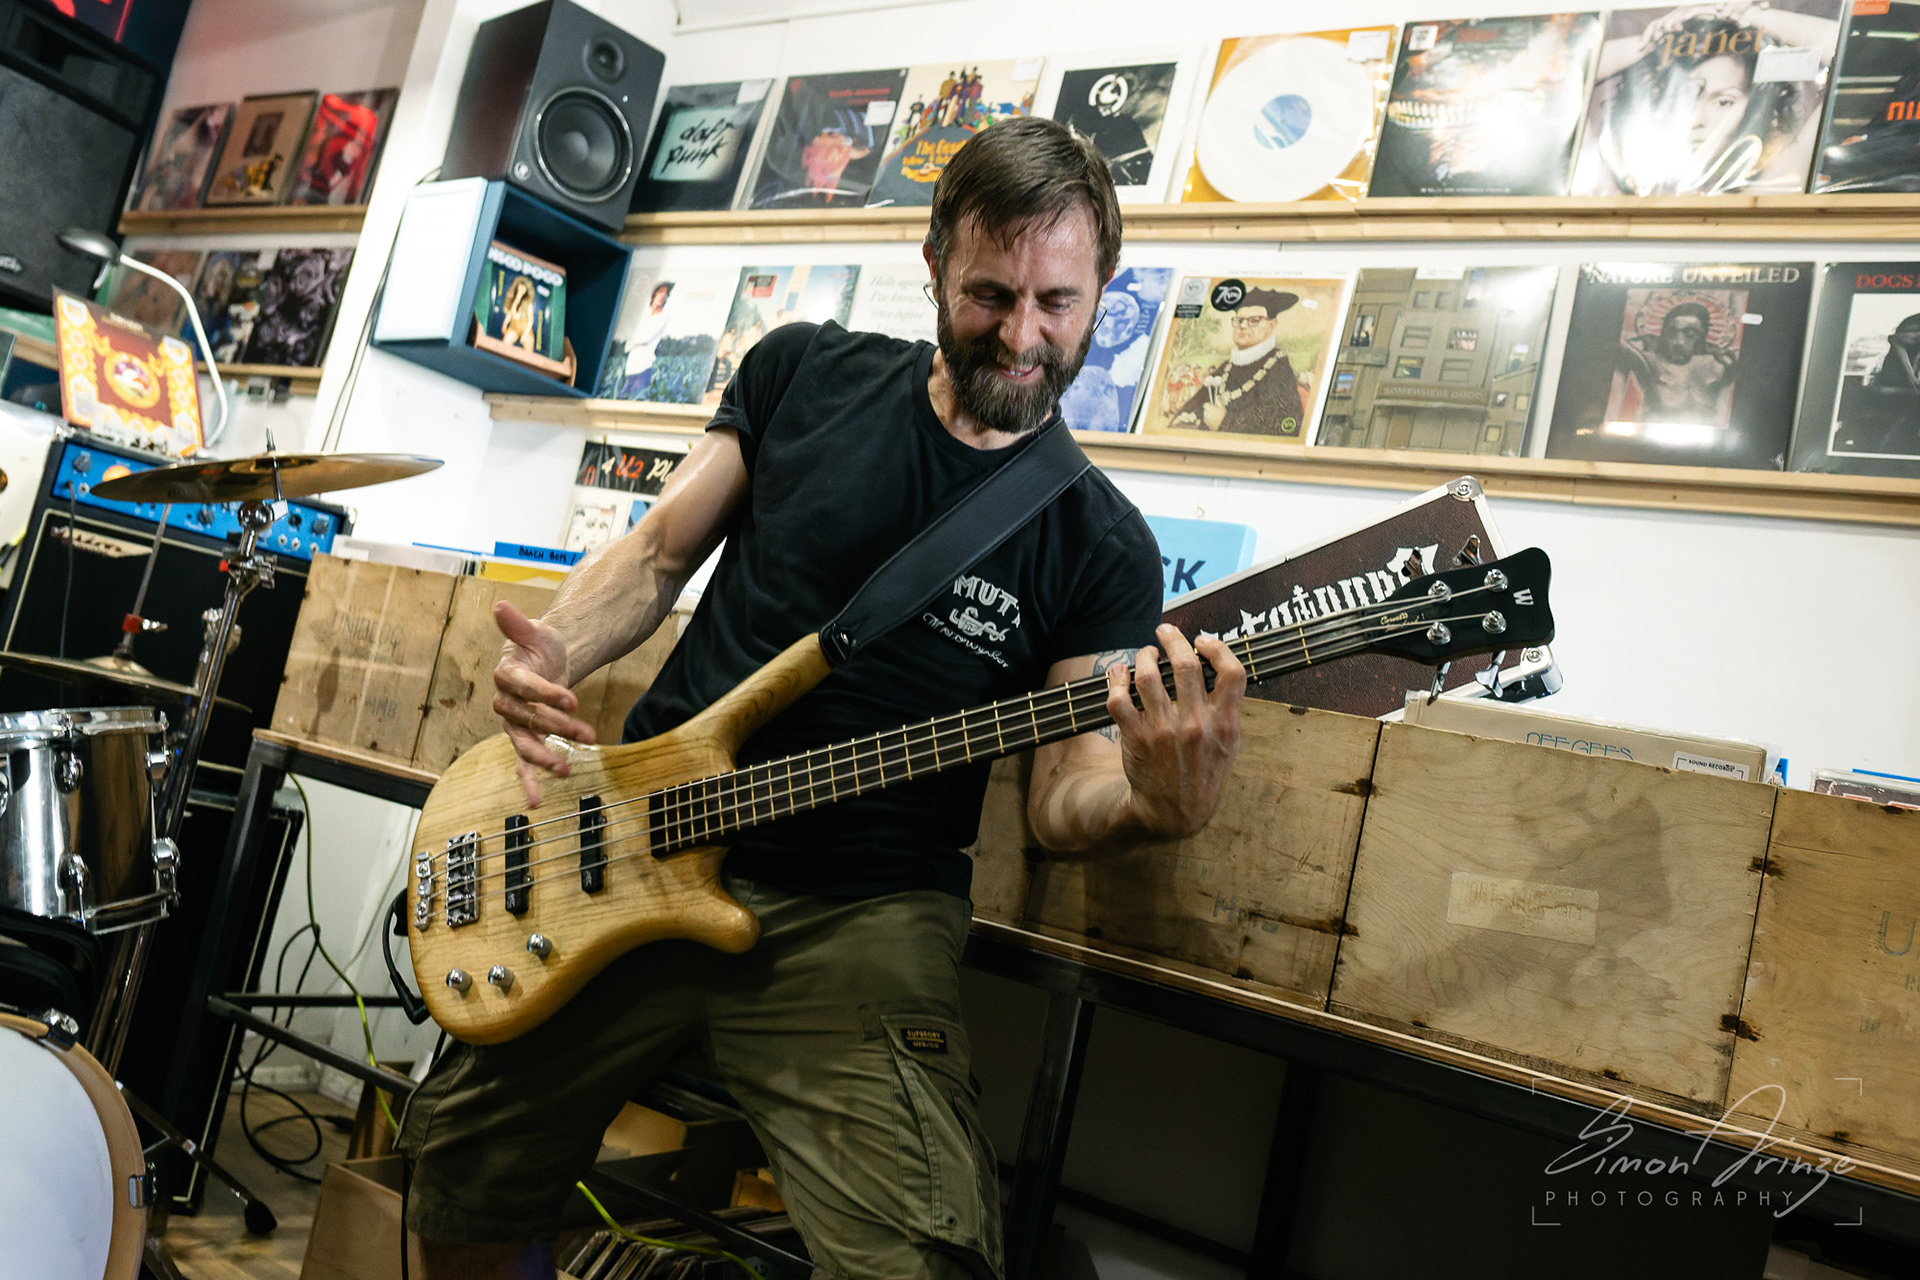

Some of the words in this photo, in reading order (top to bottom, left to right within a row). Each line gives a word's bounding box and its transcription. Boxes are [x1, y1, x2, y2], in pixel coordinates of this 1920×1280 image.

[680, 118, 735, 147] daft
[661, 136, 728, 173] punk
[1681, 265, 1800, 284] UNVEILED
[1856, 273, 1913, 289] DOGS
